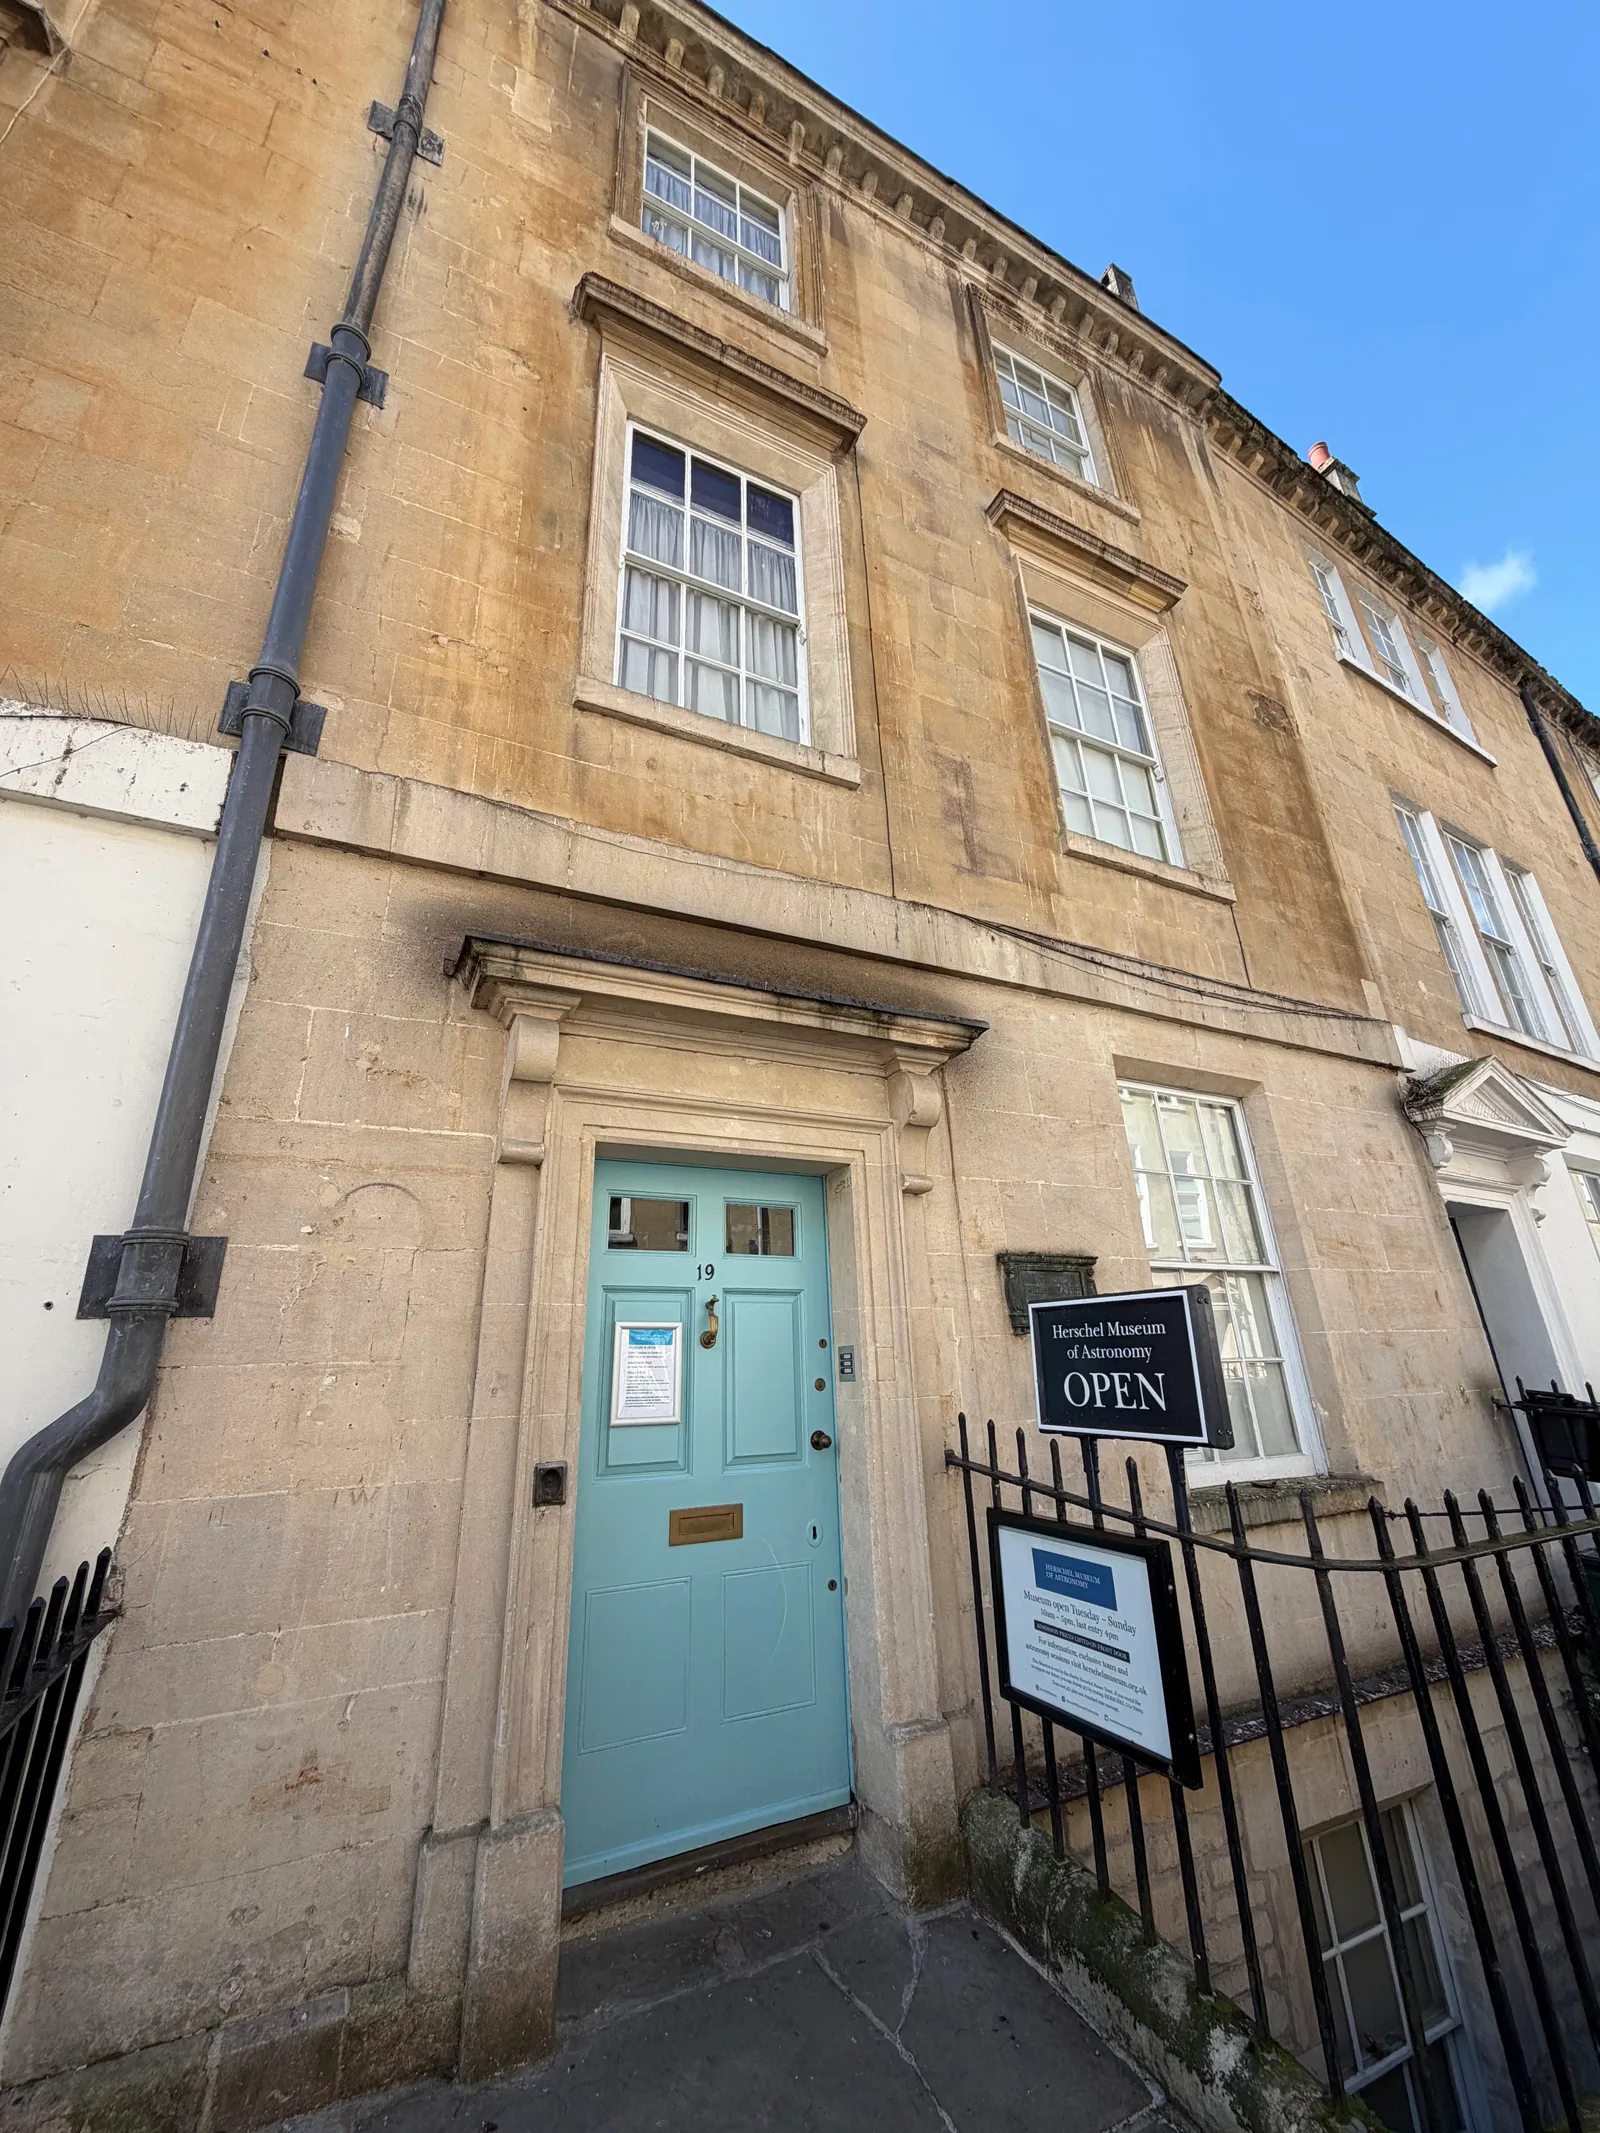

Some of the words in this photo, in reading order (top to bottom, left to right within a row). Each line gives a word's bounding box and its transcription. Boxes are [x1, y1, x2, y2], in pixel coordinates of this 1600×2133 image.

[696, 1264, 714, 1281] 19
[1052, 1322, 1104, 1339] Herschel
[1108, 1321, 1166, 1337] Museum
[1067, 1345, 1079, 1360] of
[1081, 1344, 1152, 1363] Astronomy
[1064, 1372, 1167, 1411] OPEN
[1045, 1563, 1073, 1577] HERSCHEL
[1074, 1571, 1100, 1584] MUSEUM
[1054, 1574, 1088, 1589] ASTRONOMY
[1024, 1589, 1052, 1606] Museum
[1053, 1600, 1069, 1613] open
[1070, 1604, 1100, 1624] Tuesday
[1108, 1616, 1137, 1636] Sunday
[1041, 1608, 1055, 1620] 10am
[1061, 1616, 1075, 1627] 5pm,
[1076, 1619, 1087, 1630] last
[1088, 1625, 1105, 1636] entry
[1105, 1628, 1119, 1641] 4pm
[1036, 1623, 1059, 1635] ADMISSION
[1059, 1630, 1074, 1640] PRICES
[1074, 1635, 1089, 1646] LISTED
[1098, 1643, 1112, 1655] FRONT
[1113, 1648, 1128, 1660] DOOR
[1038, 1636, 1046, 1646] For
[1048, 1639, 1078, 1658] information,
[1079, 1652, 1101, 1666] exclusive
[1102, 1659, 1117, 1671] tours
[1118, 1666, 1128, 1677] and
[1025, 1643, 1050, 1658] astronomy
[1051, 1652, 1070, 1664] sessions
[1071, 1658, 1081, 1669] visit
[1082, 1662, 1148, 1696] herschelmuseum.org.uk
